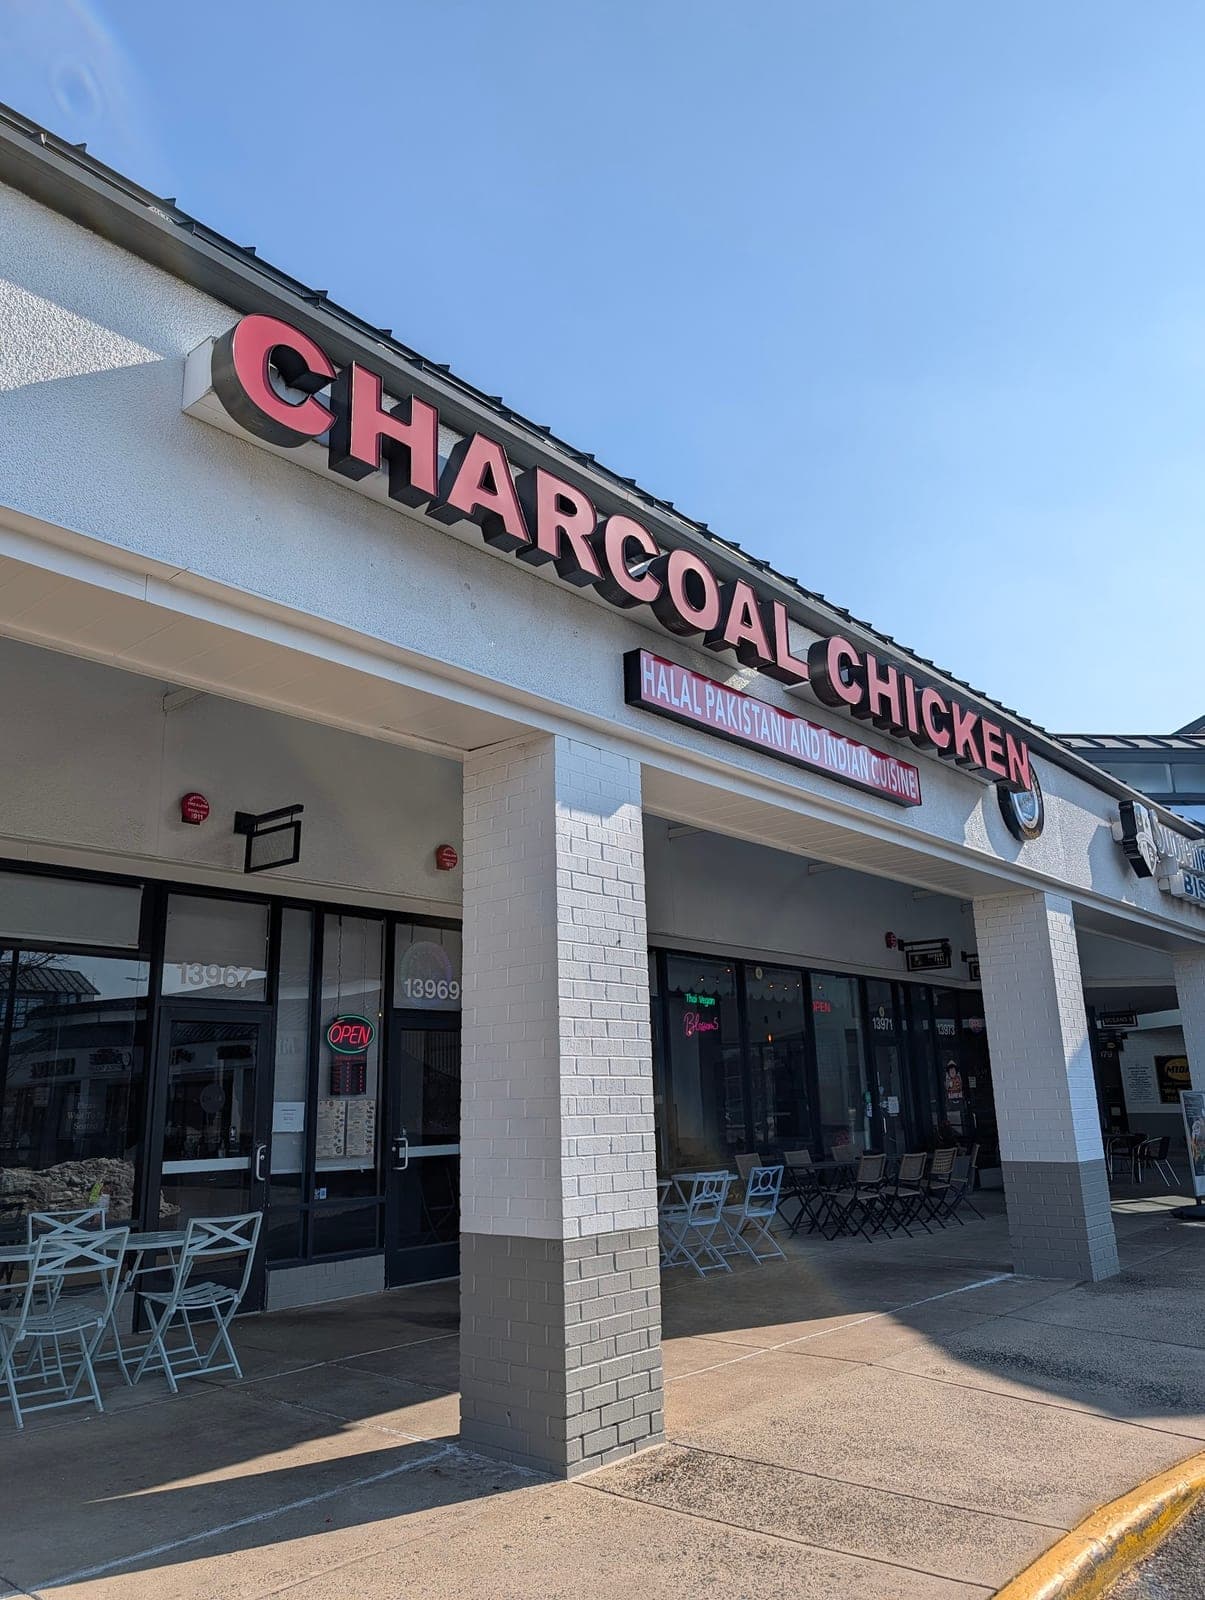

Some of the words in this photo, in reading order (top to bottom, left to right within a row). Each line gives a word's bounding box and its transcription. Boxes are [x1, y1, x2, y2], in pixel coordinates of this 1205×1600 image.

[231, 312, 810, 681] CHARCOAL
[827, 634, 1032, 791] CHICKEN
[642, 656, 702, 716] HALAL
[705, 684, 787, 750] PAKISTANI
[790, 720, 820, 761] AND
[823, 733, 869, 781] INDIAN
[871, 755, 917, 799] CUISINE
[177, 961, 254, 988] 13967
[404, 978, 460, 1000] 13969
[329, 1024, 371, 1044] OPEN
[871, 1017, 893, 1031] 13971
